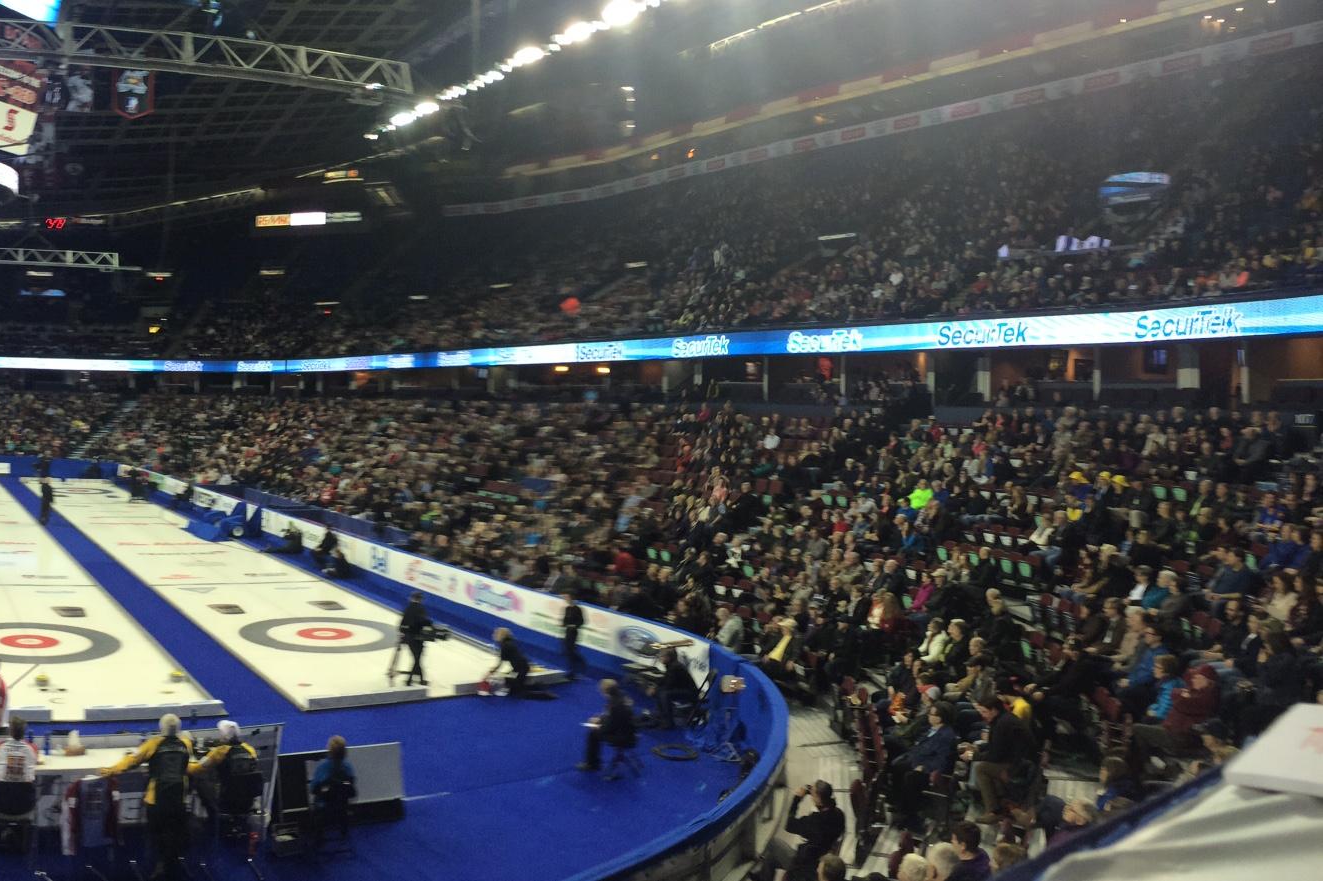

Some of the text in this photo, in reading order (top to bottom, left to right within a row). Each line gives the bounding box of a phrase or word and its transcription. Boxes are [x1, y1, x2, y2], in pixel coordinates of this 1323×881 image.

[937, 322, 1029, 346] SecurTek
[1134, 305, 1242, 339] SecurTek
[672, 335, 730, 358] SecurTek
[787, 329, 862, 353] SecurTek
